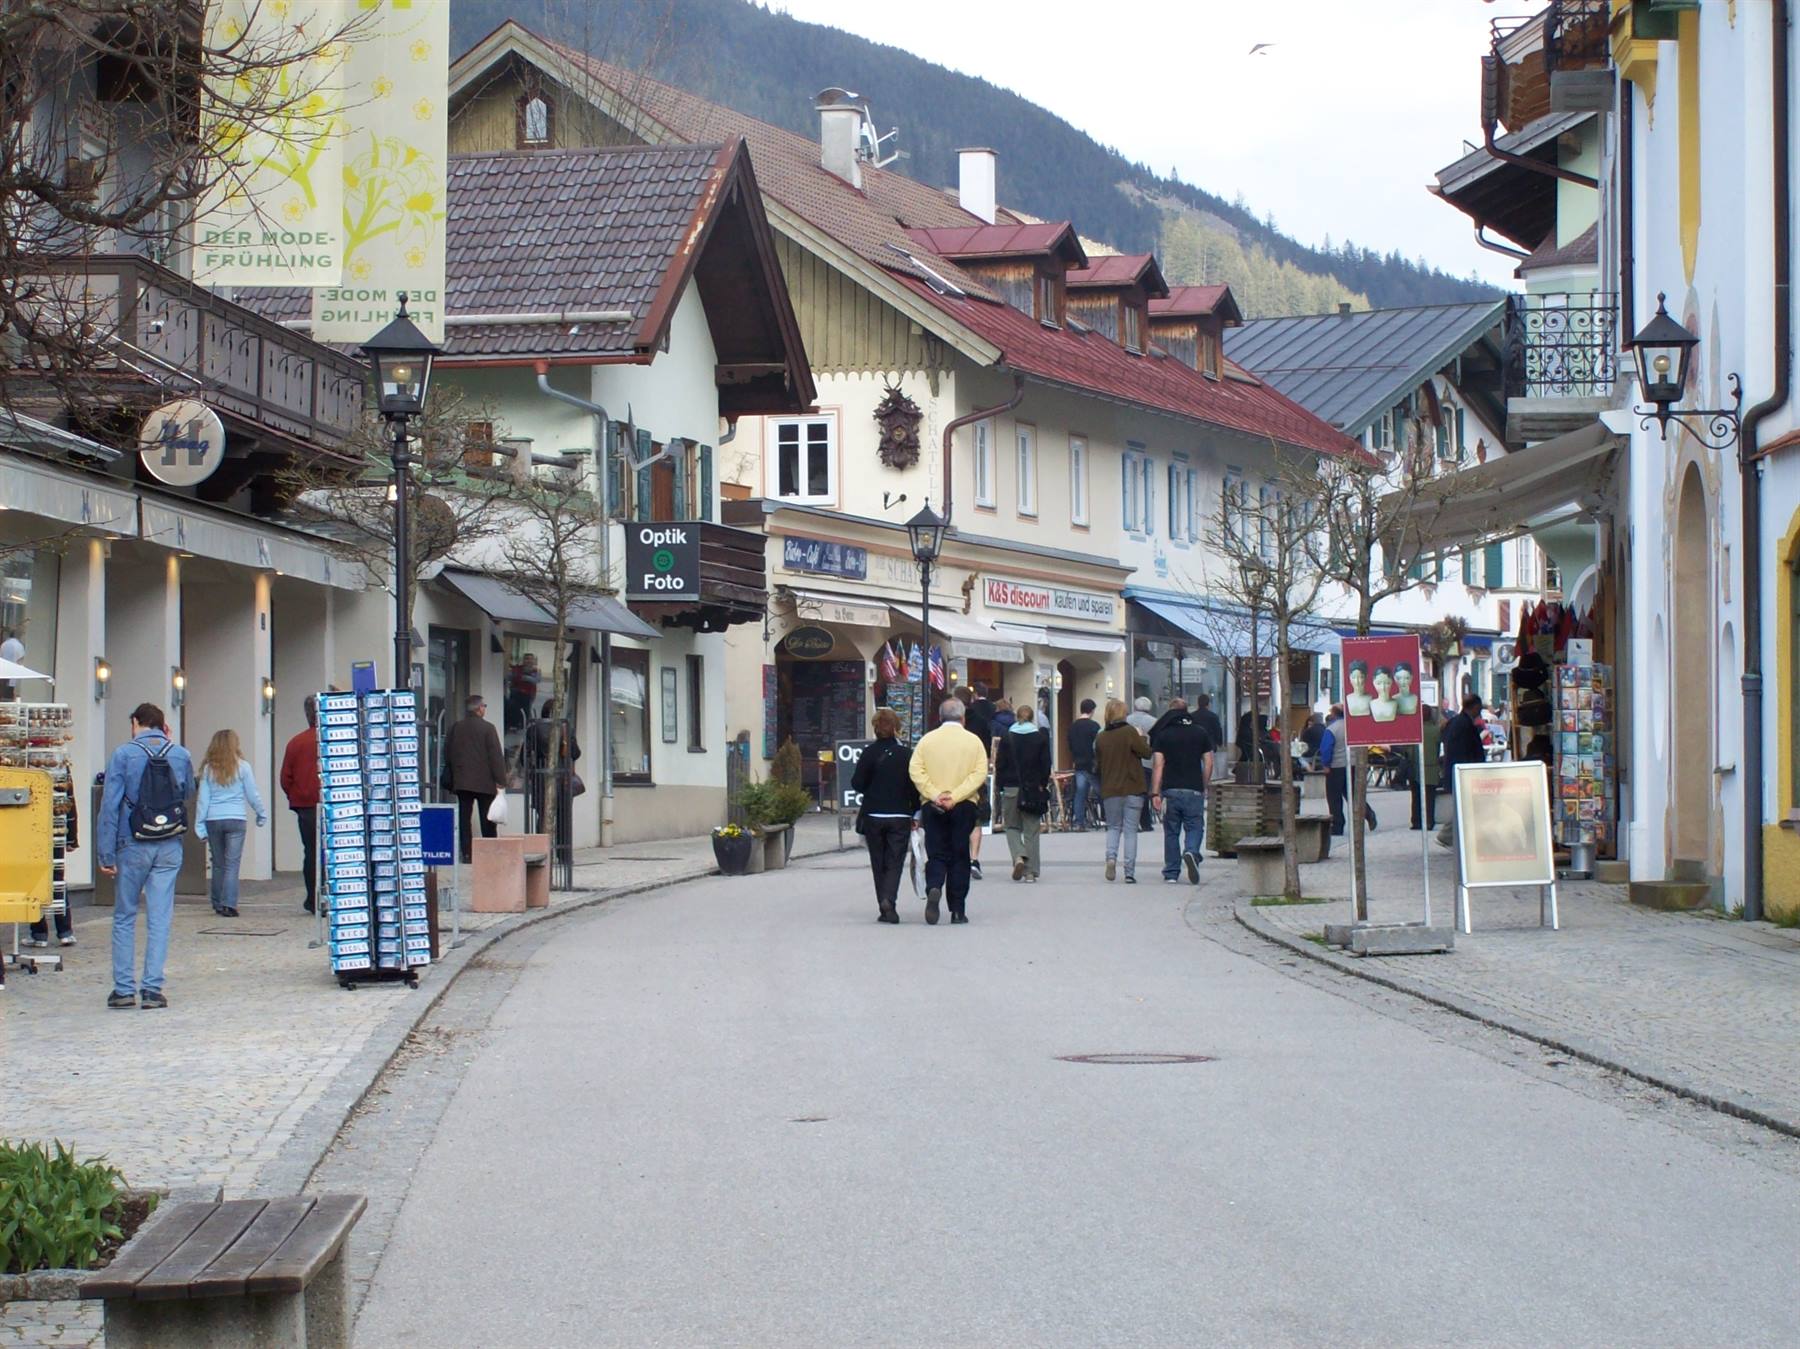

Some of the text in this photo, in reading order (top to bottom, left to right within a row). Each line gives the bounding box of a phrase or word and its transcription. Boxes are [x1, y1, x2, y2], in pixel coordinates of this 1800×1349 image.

[204, 231, 336, 245] DER MODE-
[205, 252, 333, 268] FRÜHLING
[640, 528, 688, 548] Optik
[644, 573, 685, 590] Foto
[988, 580, 1113, 617] K&S discount kaufen und sparen
[838, 744, 870, 764] Op
[423, 851, 451, 859] TILIEN
